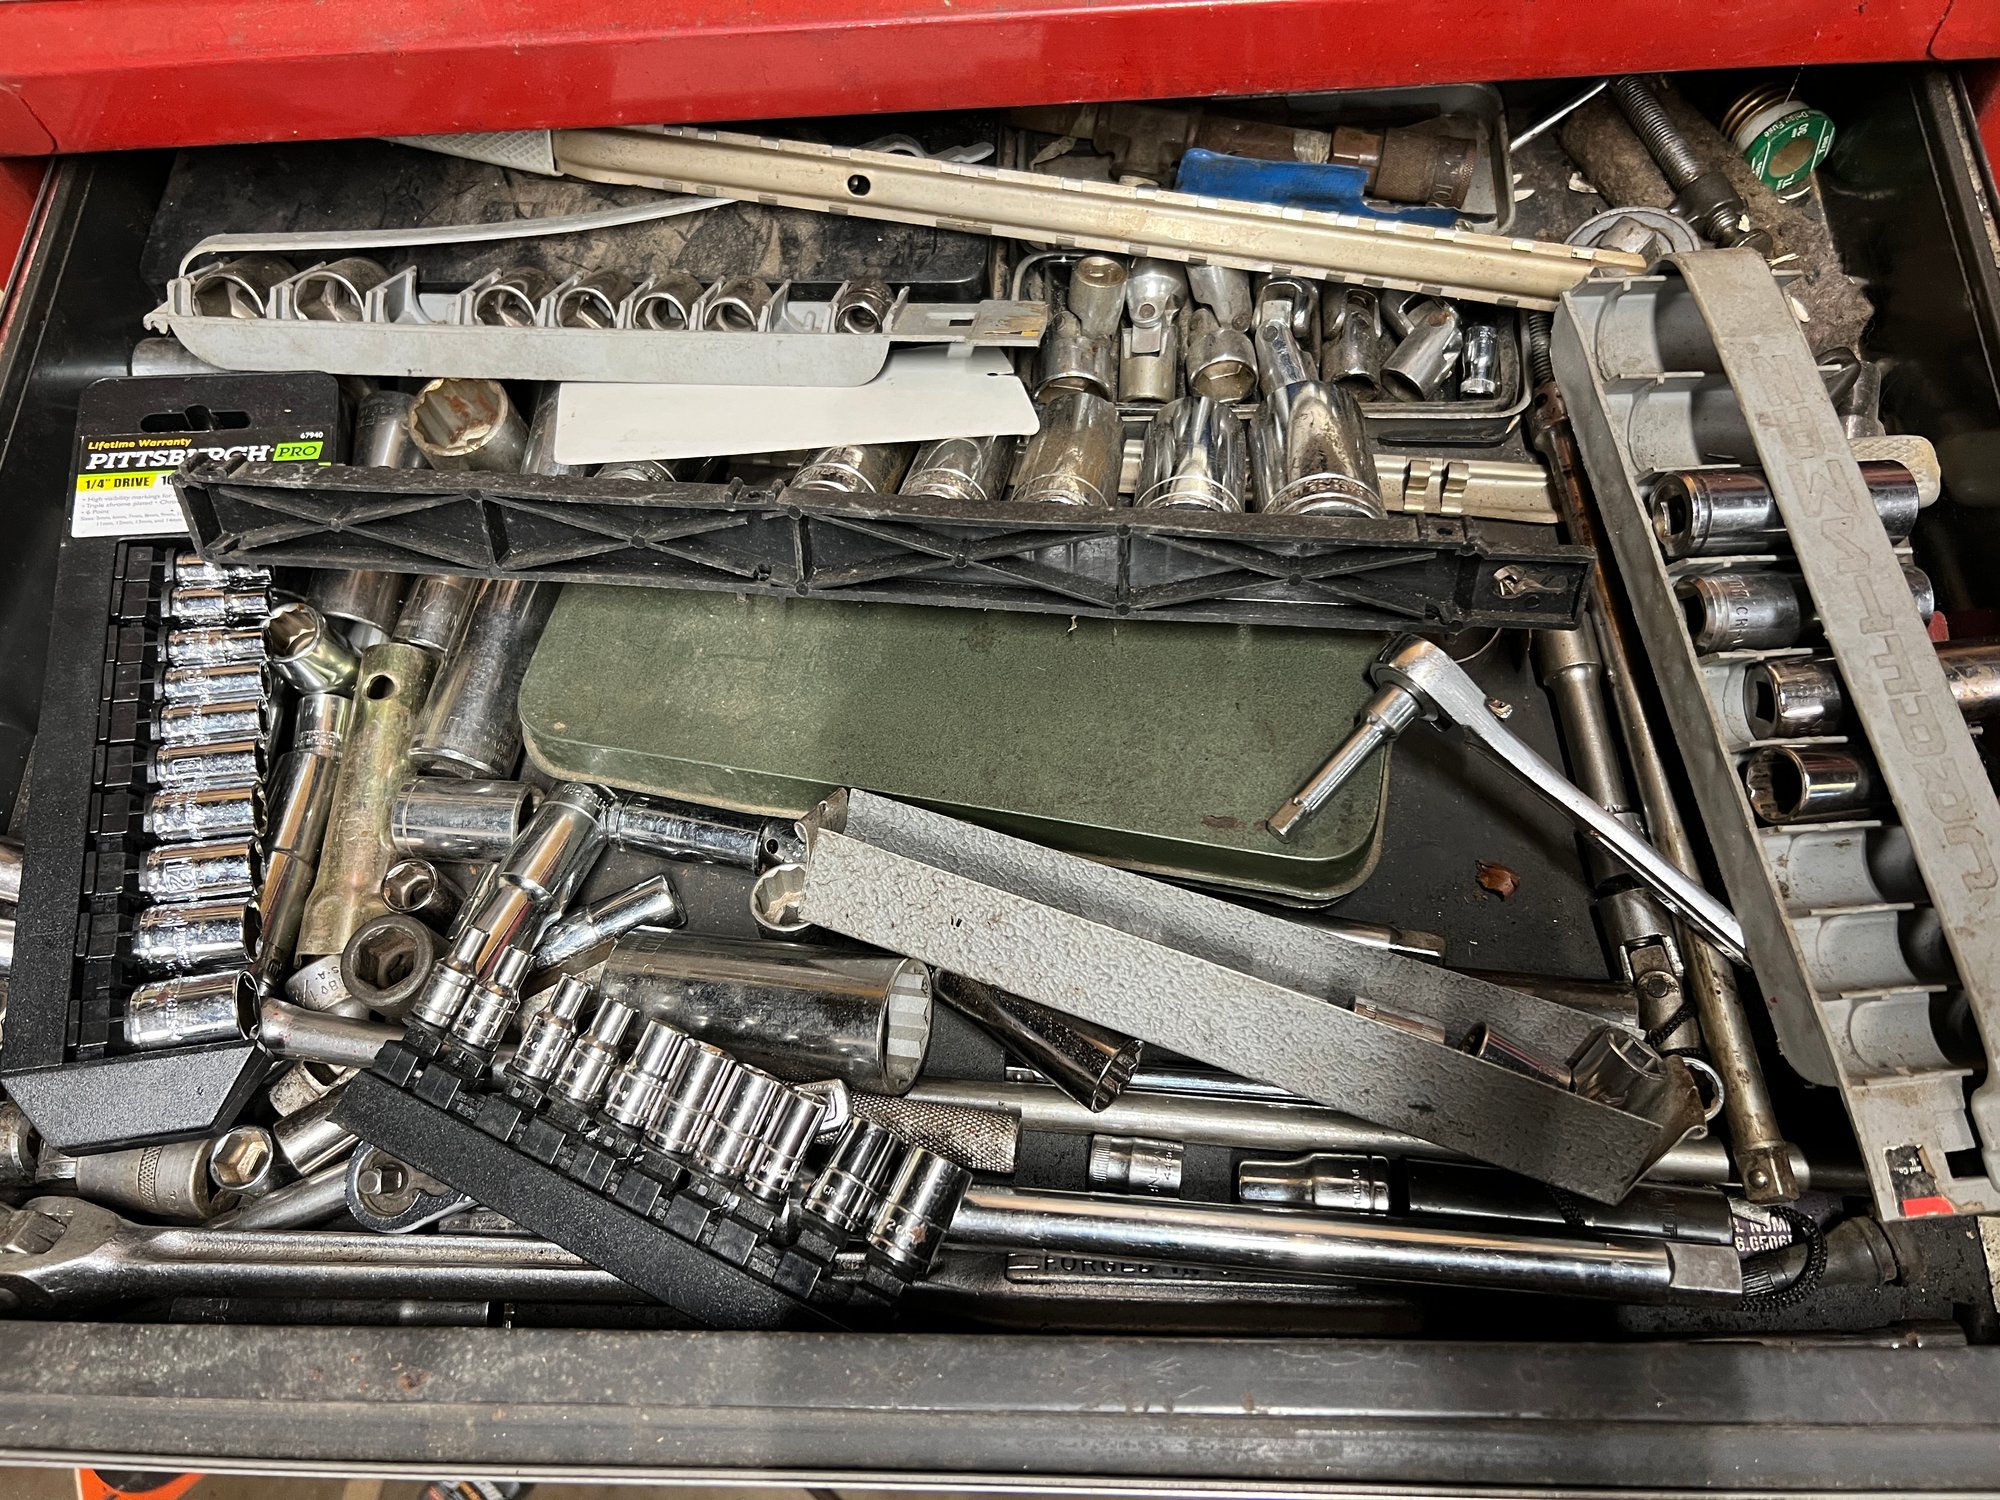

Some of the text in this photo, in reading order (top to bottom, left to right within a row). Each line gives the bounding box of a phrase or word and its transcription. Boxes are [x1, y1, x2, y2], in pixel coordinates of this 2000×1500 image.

[300, 431, 324, 440] 67940
[88, 438, 192, 451] Lifetime Warranty
[278, 446, 317, 458] PRO
[86, 479, 110, 489] 1/4"
[114, 477, 149, 488] DRIVE
[1751, 353, 1999, 895] CRAFTSMAN
